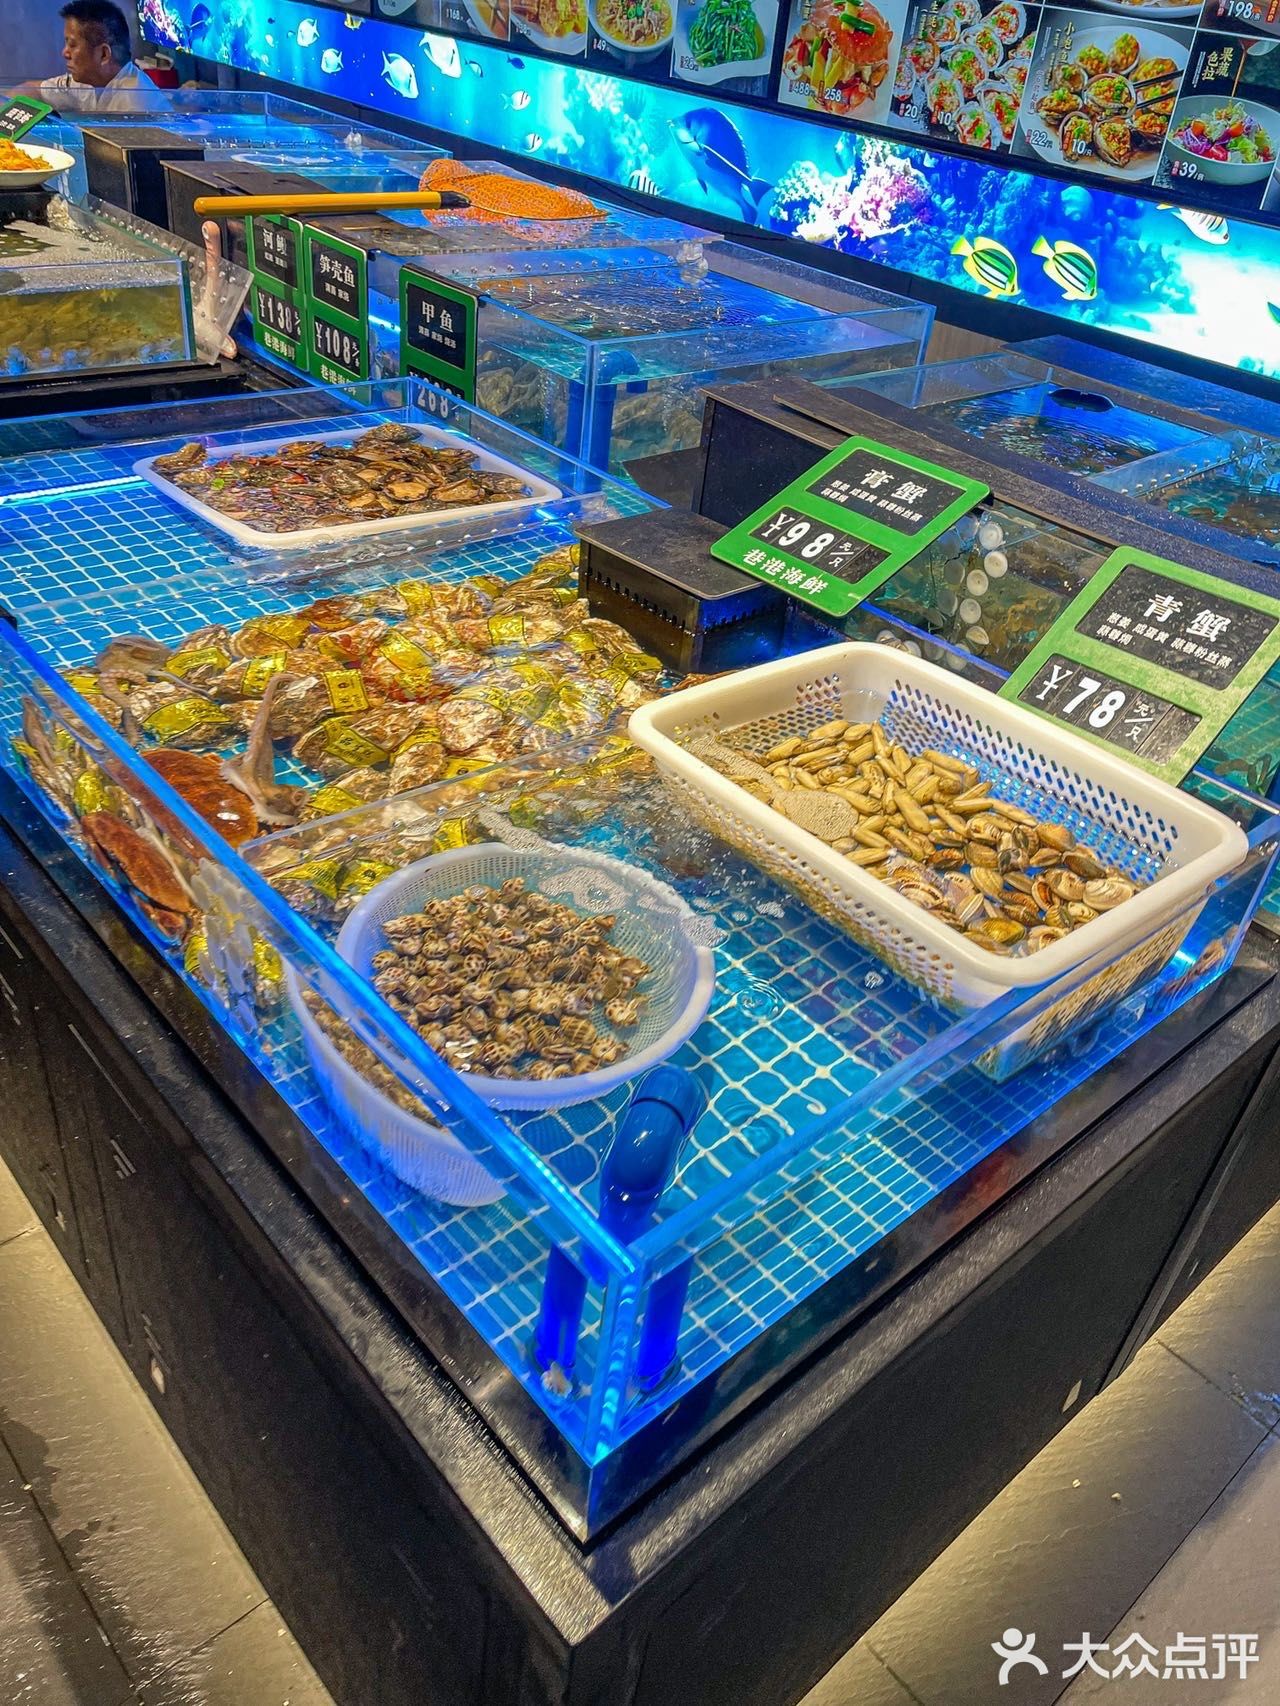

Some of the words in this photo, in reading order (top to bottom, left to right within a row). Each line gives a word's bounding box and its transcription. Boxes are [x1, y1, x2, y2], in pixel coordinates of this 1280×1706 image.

[1202, 52, 1220, 82] 色拉
[1216, 47, 1234, 78] 果蔬
[904, 103, 918, 118] 20
[319, 254, 356, 288] 笋壳鱼
[421, 301, 454, 333] 甲鱼
[742, 547, 829, 596] 巷港海鲜
[1141, 593, 1232, 643] 青蟹
[1035, 664, 1127, 729] ¥78
